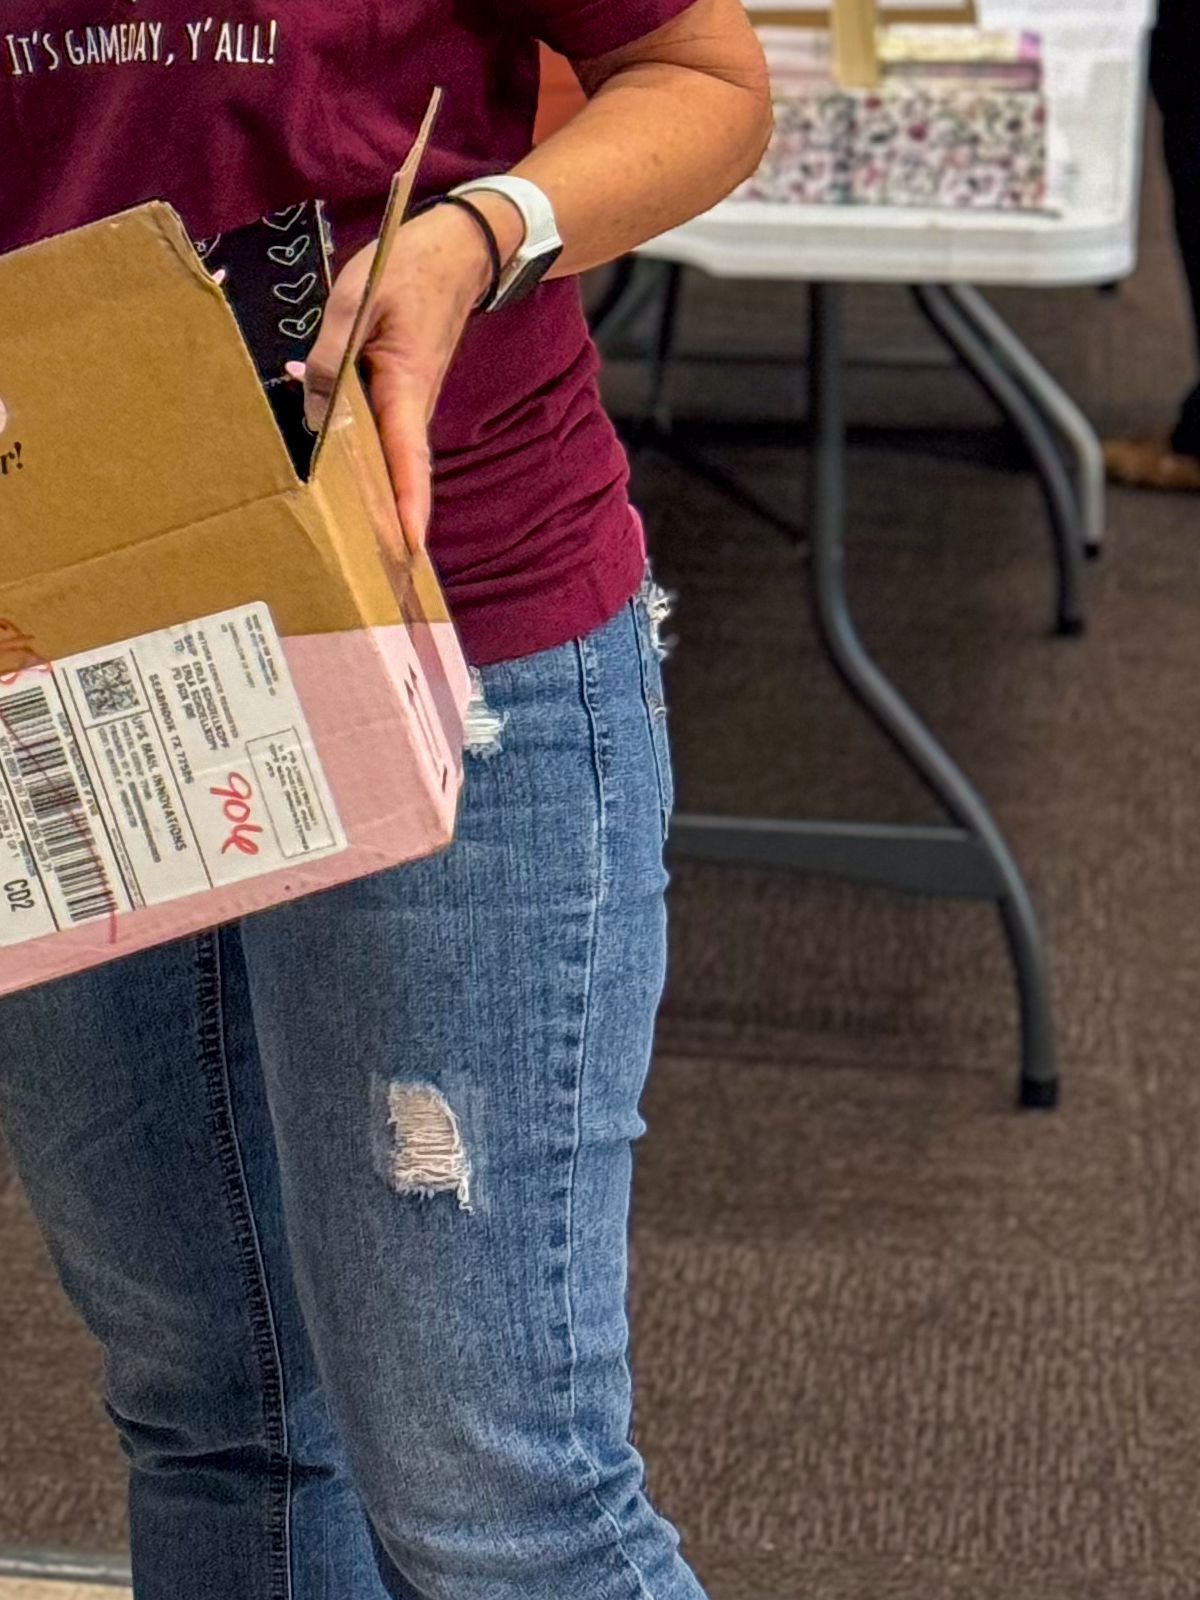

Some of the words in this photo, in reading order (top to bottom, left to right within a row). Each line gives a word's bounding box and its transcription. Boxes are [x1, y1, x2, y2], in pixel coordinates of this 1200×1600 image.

[4, 33, 59, 76] IT'S
[65, 20, 176, 67] GAMEDAY,
[186, 15, 278, 66] Y'ALL!
[131, 714, 149, 741] UPS
[151, 773, 188, 852] INNOVATIONS
[2, 878, 35, 912] CD2
